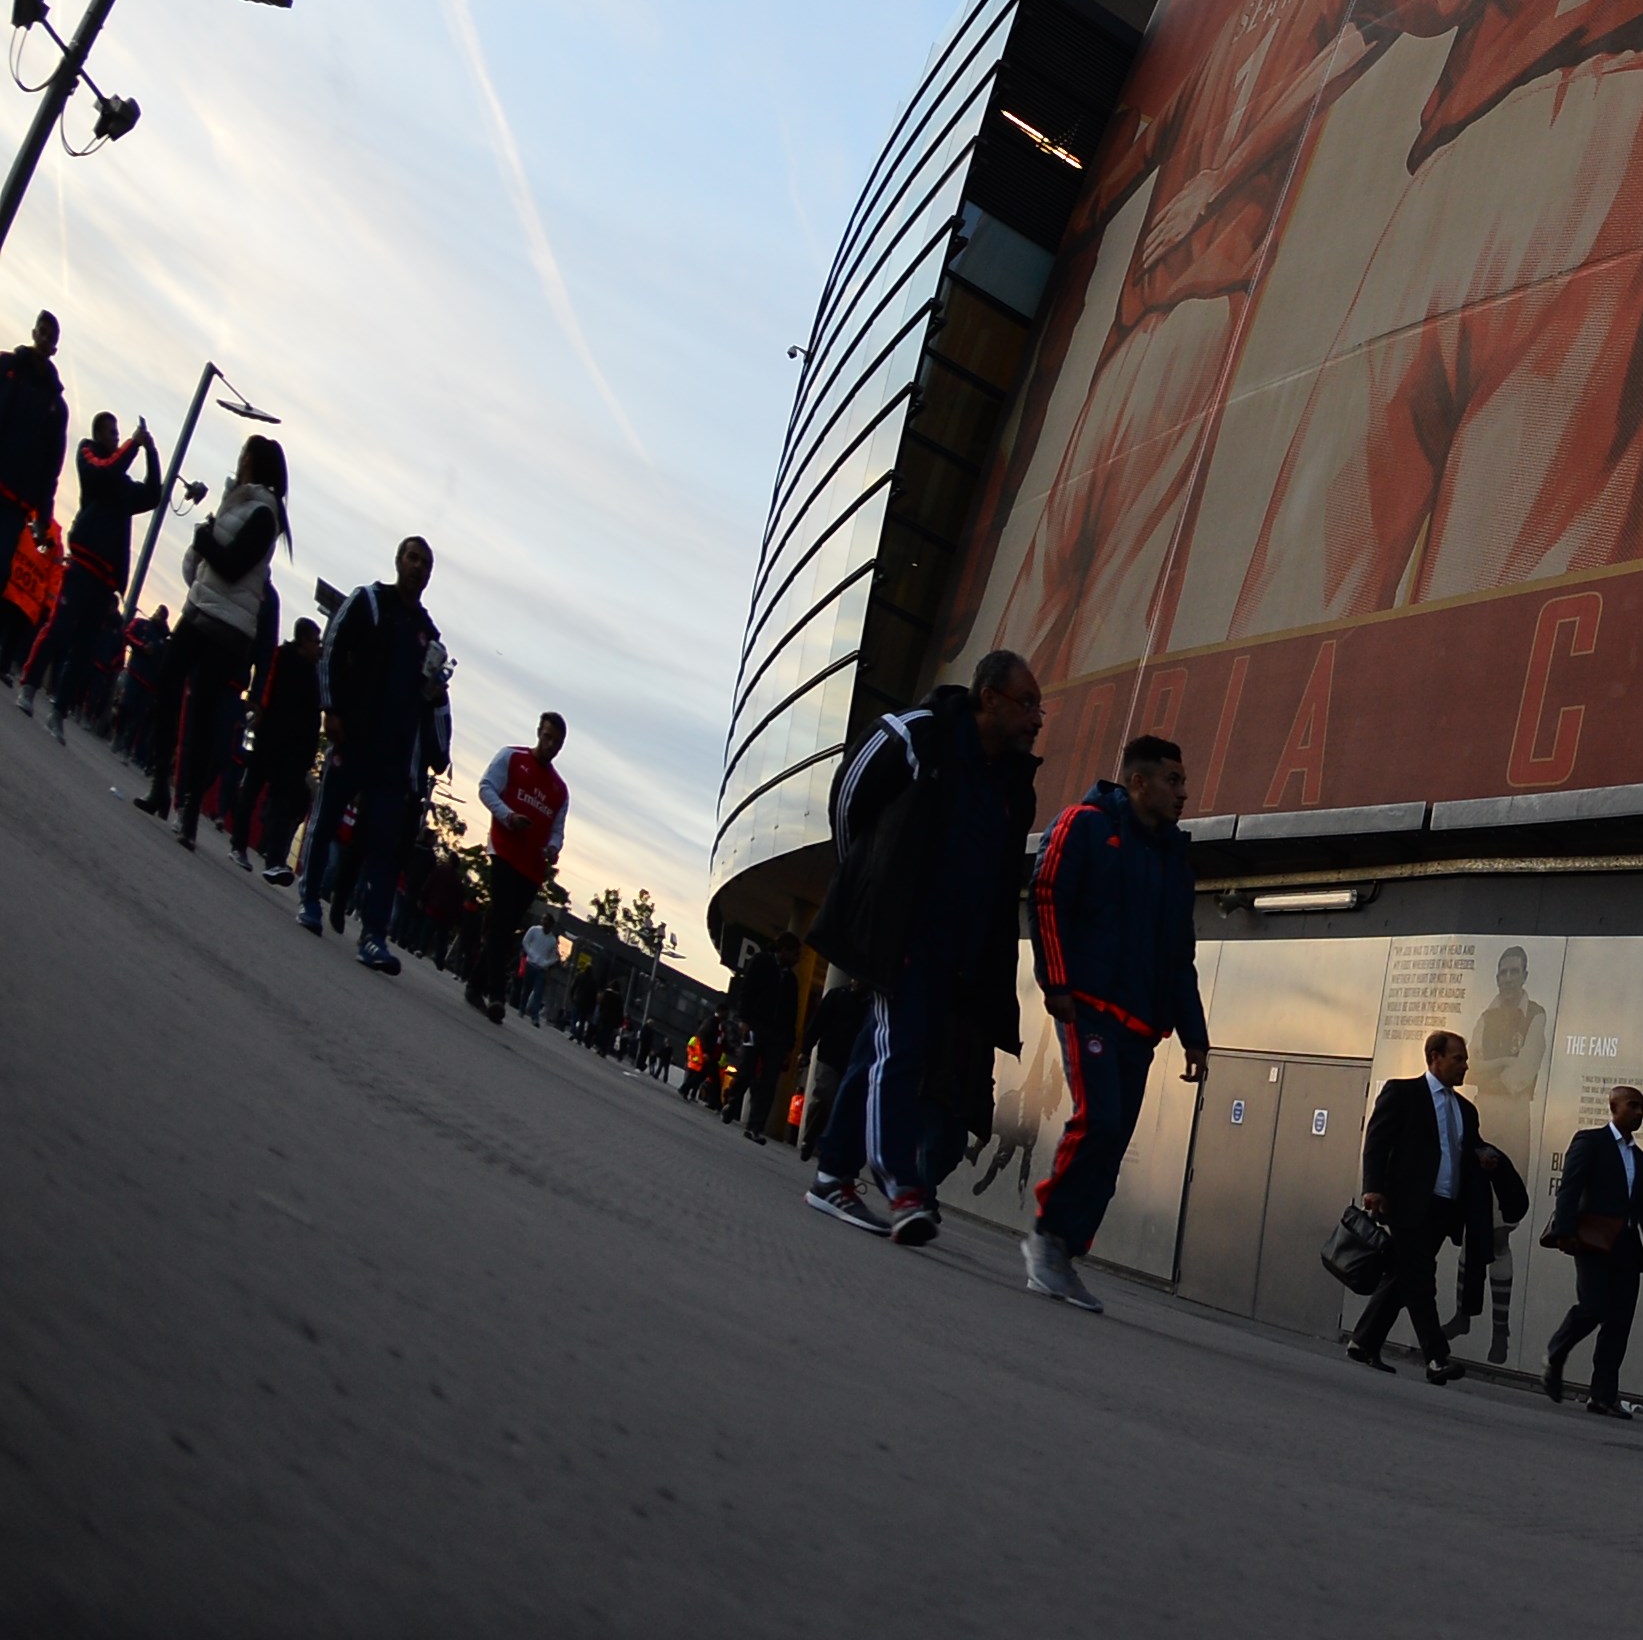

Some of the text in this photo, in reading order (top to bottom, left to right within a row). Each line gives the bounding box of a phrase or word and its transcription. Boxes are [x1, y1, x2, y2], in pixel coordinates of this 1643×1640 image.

[517, 787, 553, 818] Emirate
[1566, 1036, 1618, 1057] THE FANS
